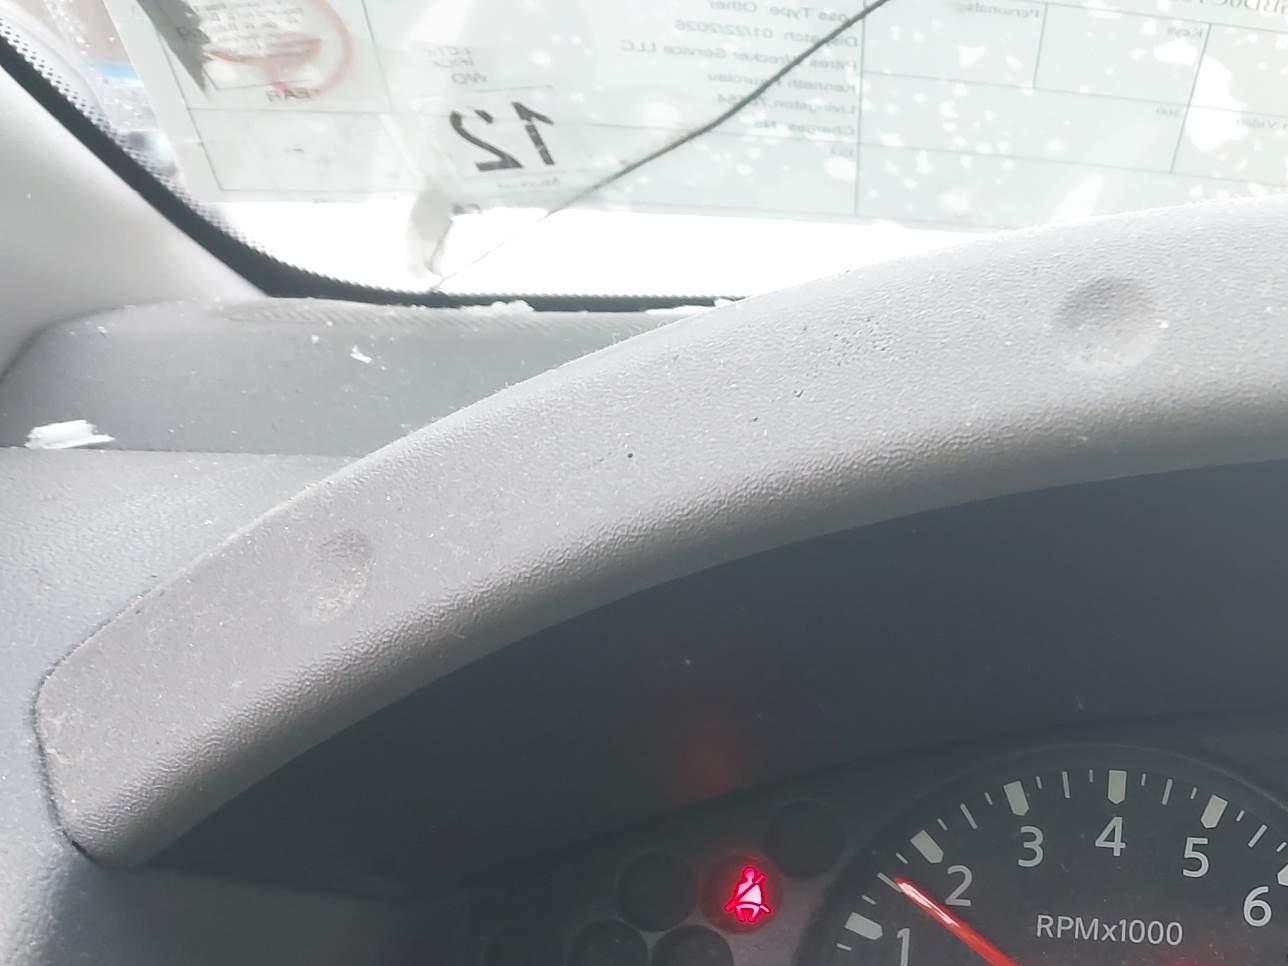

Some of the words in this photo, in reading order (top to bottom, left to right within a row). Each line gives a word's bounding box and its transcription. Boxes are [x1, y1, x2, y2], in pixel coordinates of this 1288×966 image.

[1018, 825, 1044, 867] 3
[1095, 816, 1126, 857] 4
[1182, 837, 1209, 878] 5
[944, 864, 973, 907] 2
[1243, 886, 1272, 927] 6
[1036, 914, 1184, 947] RPMx1000
